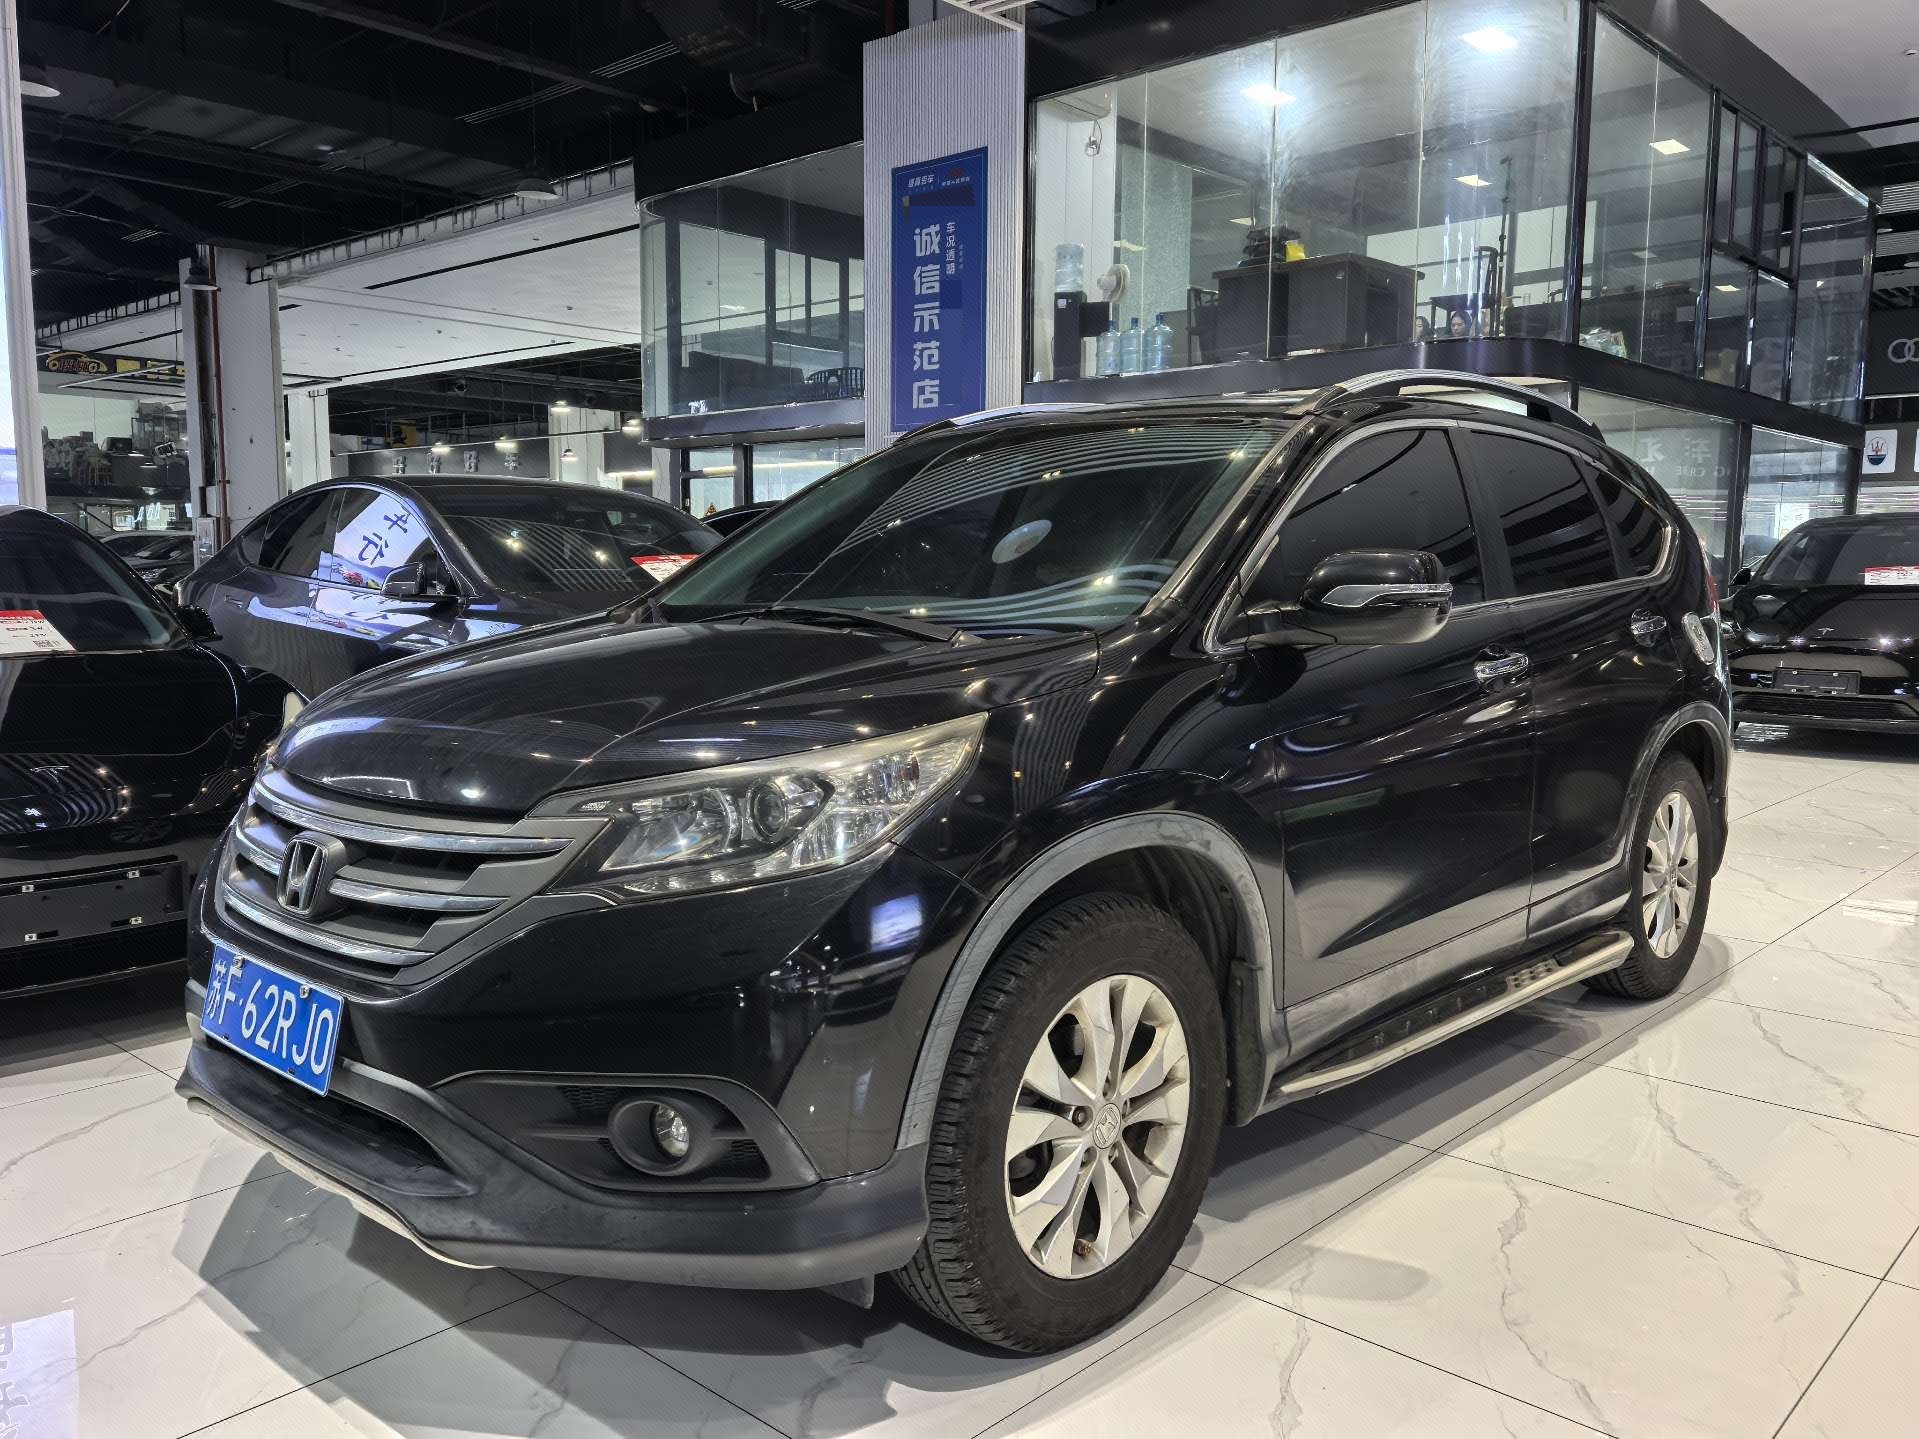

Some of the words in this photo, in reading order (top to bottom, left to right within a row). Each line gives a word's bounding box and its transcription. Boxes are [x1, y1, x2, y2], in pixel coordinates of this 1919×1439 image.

[912, 223, 941, 409] 诚信示范店
